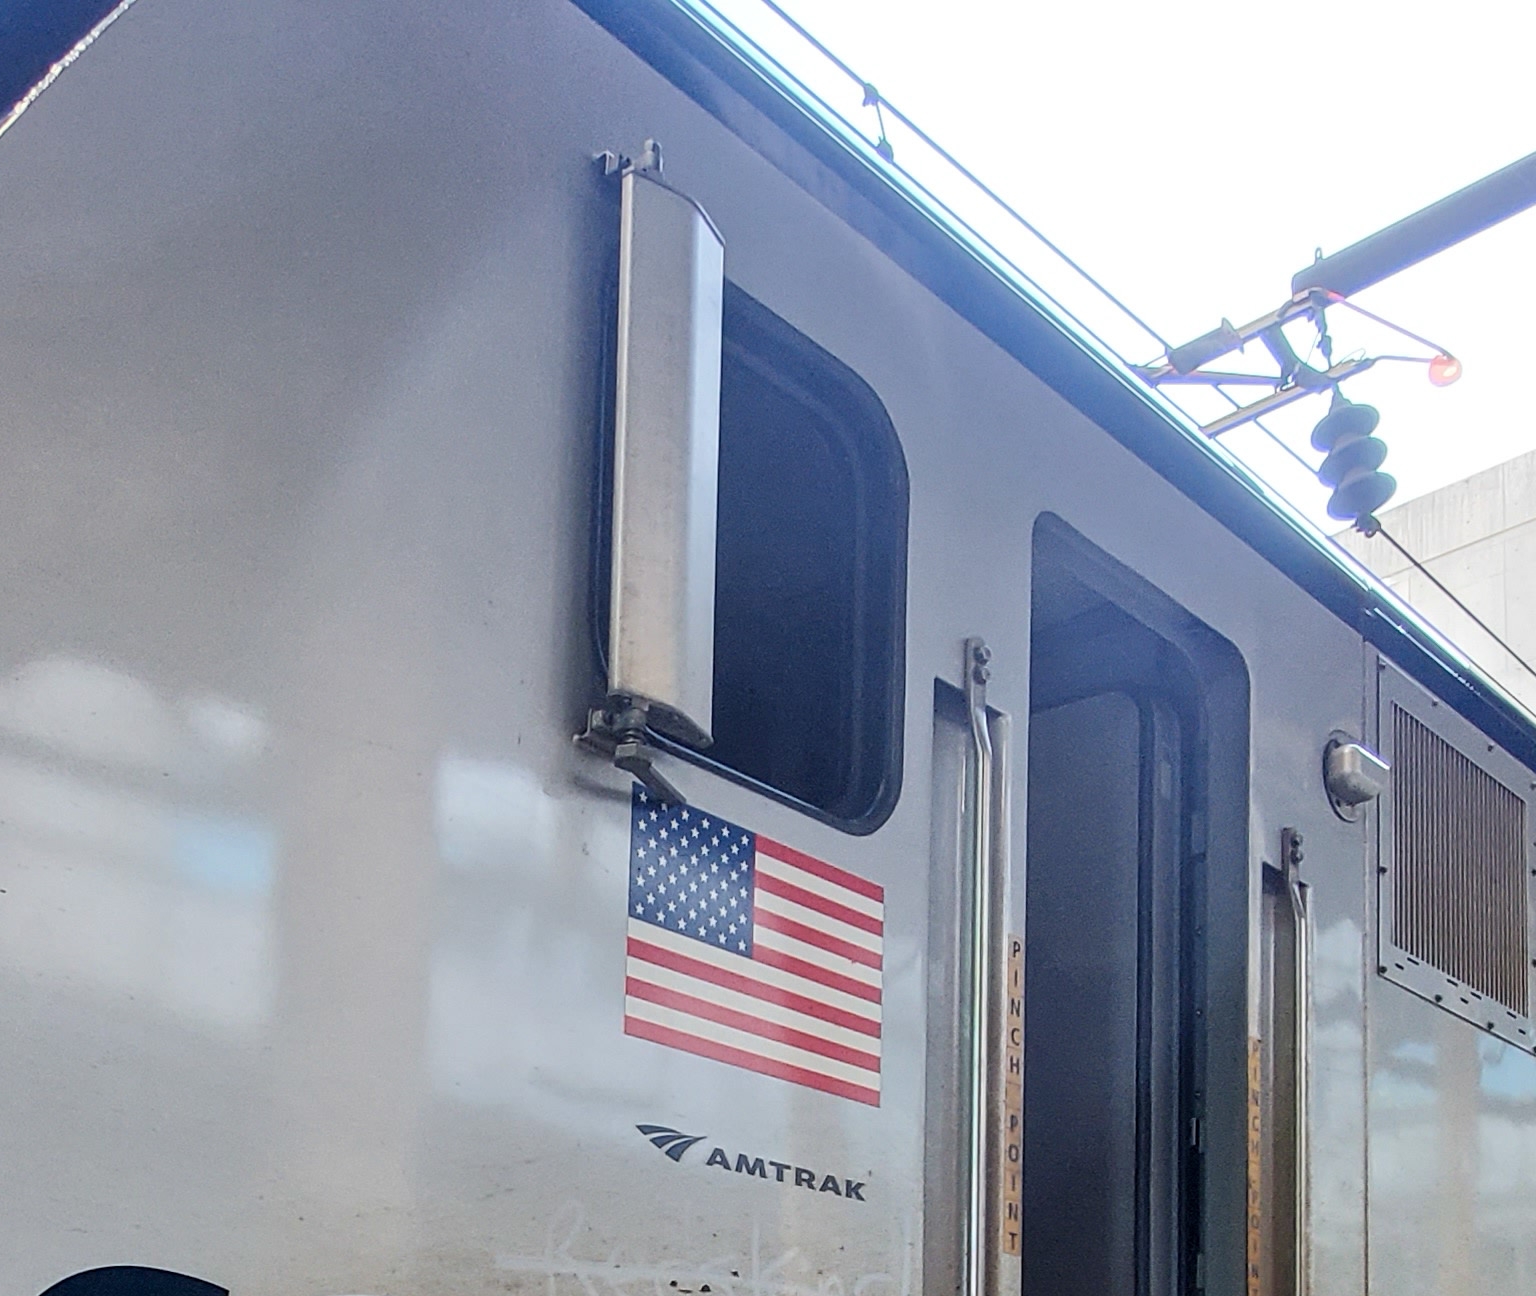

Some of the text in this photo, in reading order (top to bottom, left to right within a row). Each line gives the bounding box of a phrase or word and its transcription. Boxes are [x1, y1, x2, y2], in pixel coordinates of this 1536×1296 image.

[706, 1148, 867, 1202] AMTRAK
[1007, 941, 1022, 1251] PINCH POINT
